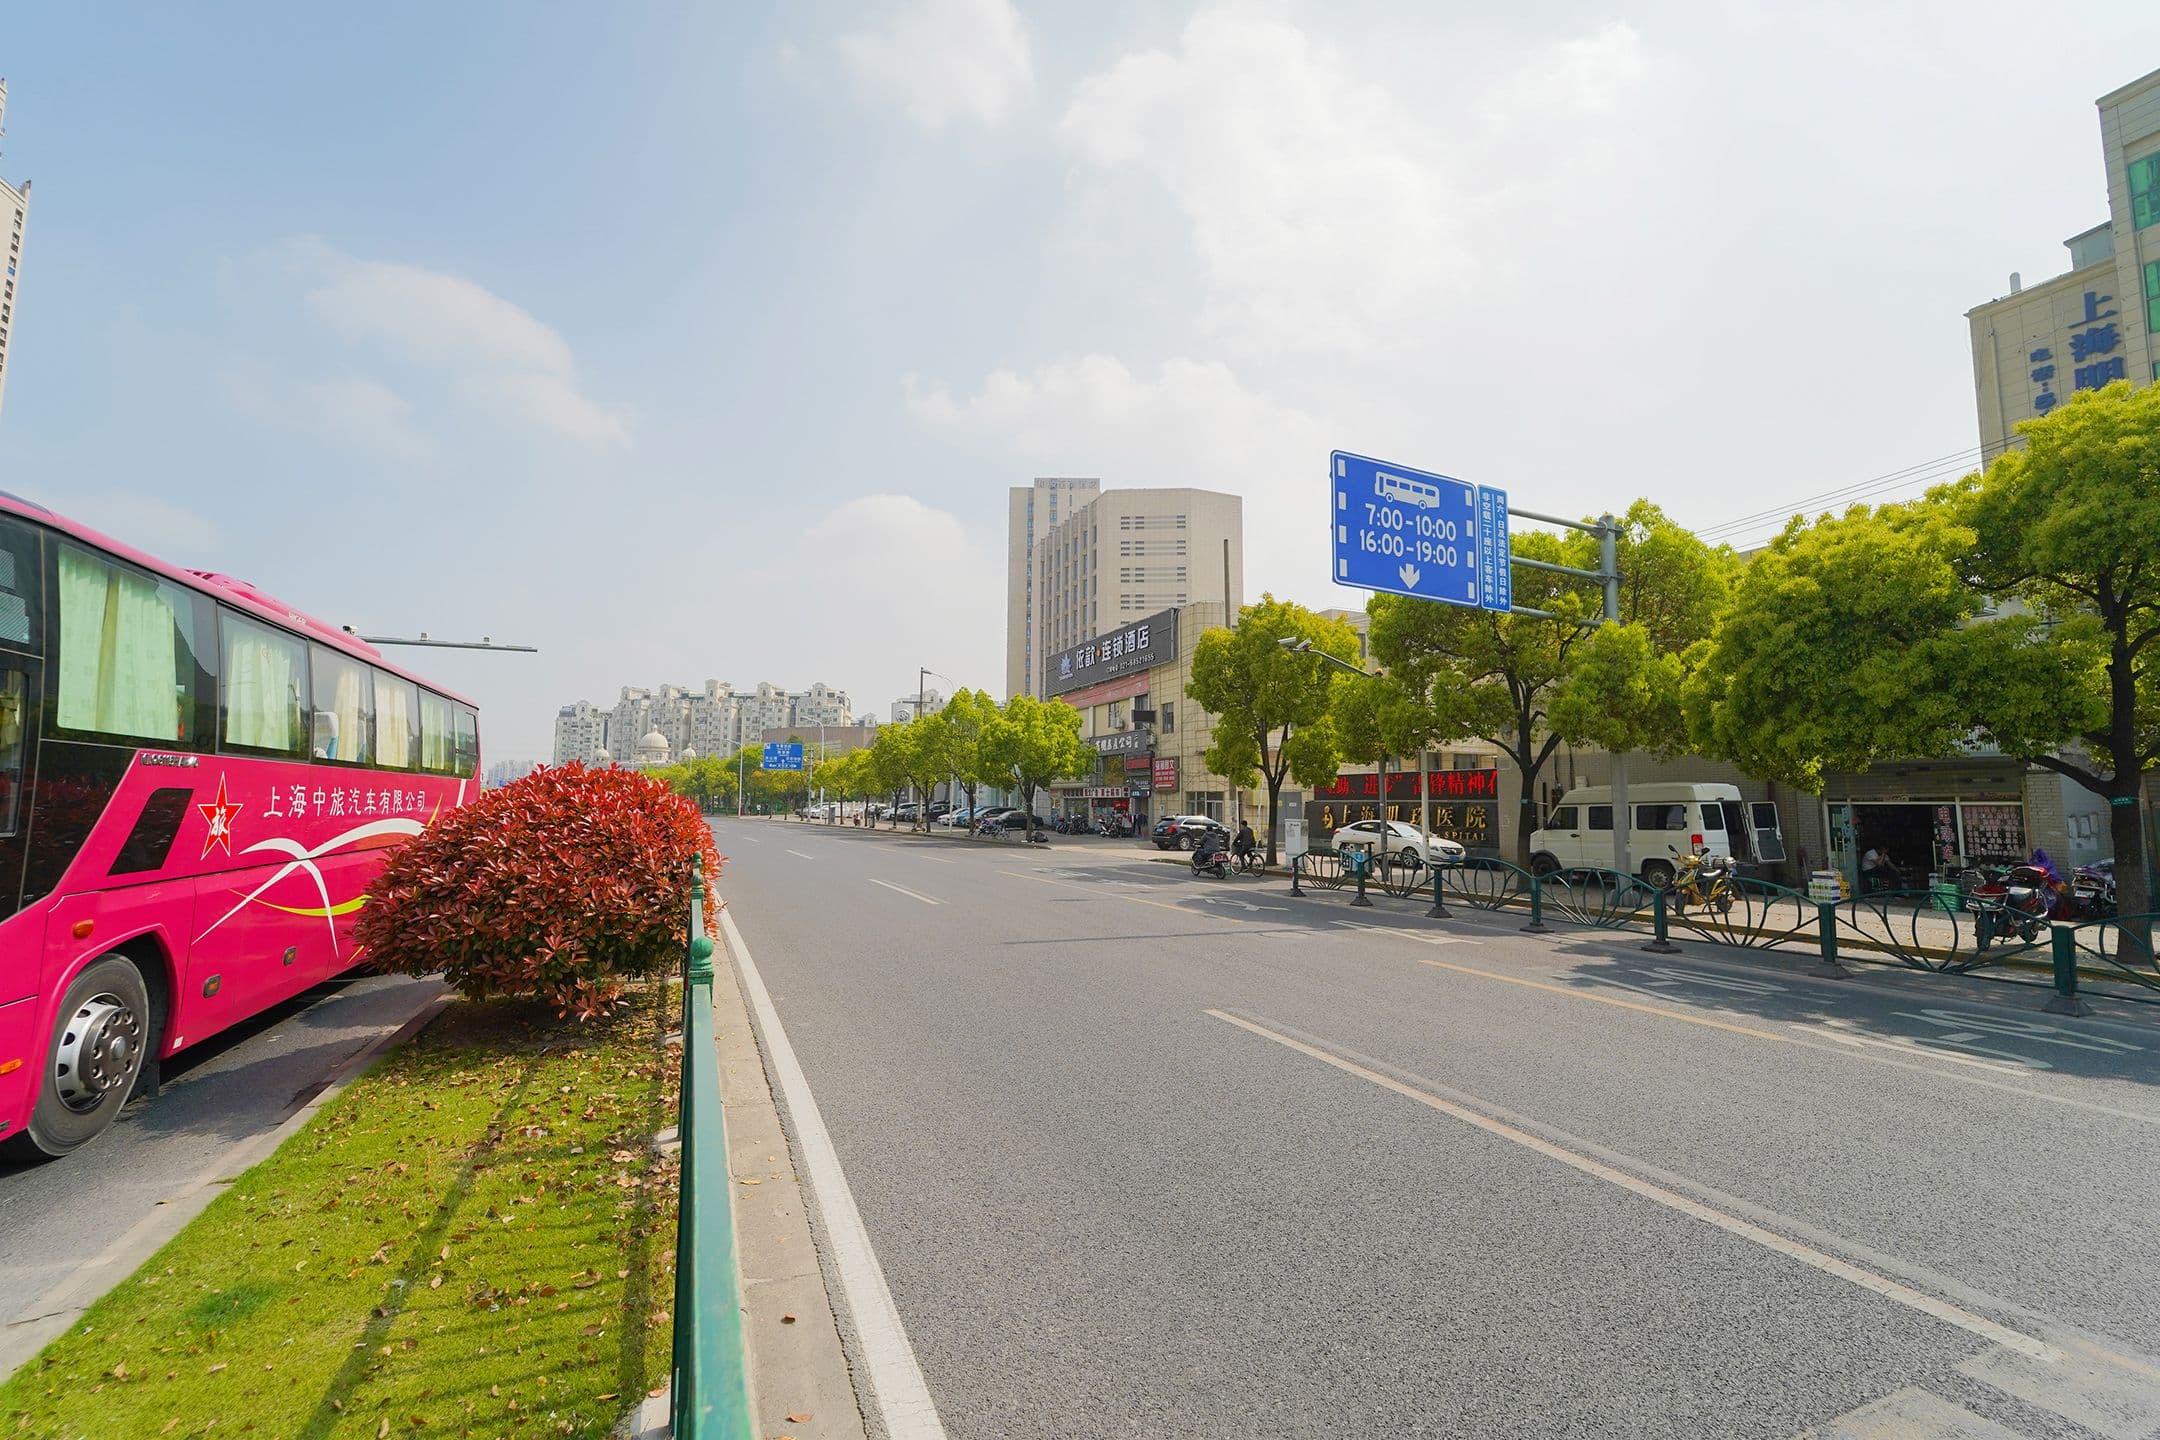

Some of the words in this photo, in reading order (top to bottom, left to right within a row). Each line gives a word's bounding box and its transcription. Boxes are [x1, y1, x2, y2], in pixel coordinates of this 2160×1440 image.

[1365, 502, 1457, 542] 7:00-10:00
[1359, 529, 1458, 568] 16:00-19:00
[263, 783, 426, 819] 上海中旅汽车有限公司
[210, 806, 229, 837] 旅
